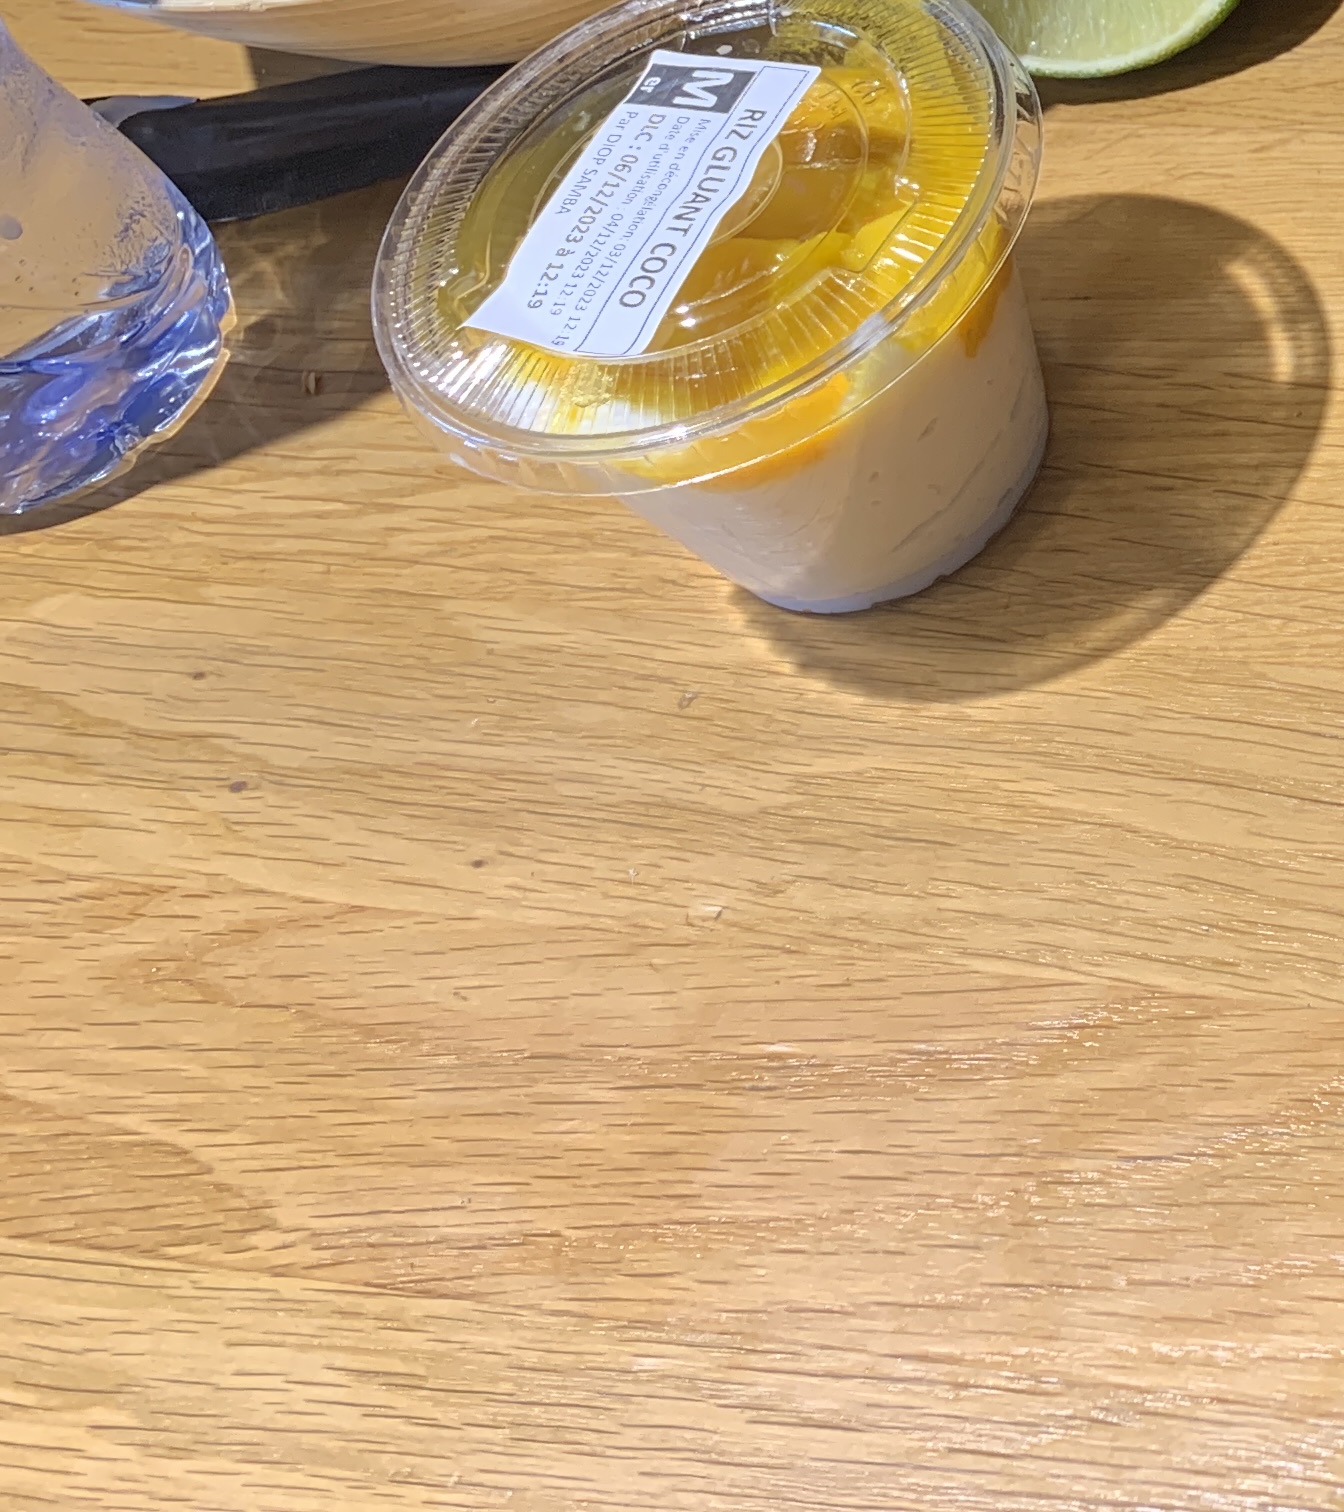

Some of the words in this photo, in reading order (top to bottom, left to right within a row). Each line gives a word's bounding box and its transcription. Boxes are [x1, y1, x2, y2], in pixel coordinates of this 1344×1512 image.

[640, 76, 662, 94] er
[672, 69, 735, 108] M
[614, 110, 638, 129] Par
[633, 112, 667, 142] DLC
[663, 115, 691, 141] Date
[684, 118, 712, 143] Mise
[724, 108, 768, 142] RIZ
[589, 133, 623, 165] DIOP
[672, 145, 690, 160] en
[620, 142, 673, 205] d'utilisation
[553, 167, 599, 216] SAMBA
[561, 153, 642, 245] 06/12/2023
[665, 144, 738, 238] GLUANT
[553, 247, 576, 258] à
[568, 212, 625, 279] 04/12/2023
[520, 261, 567, 309] 12:19
[571, 242, 629, 312] 03/12/2023
[618, 242, 678, 309] COCO
[546, 282, 579, 315] 12:19
[551, 315, 581, 347] 12:19
